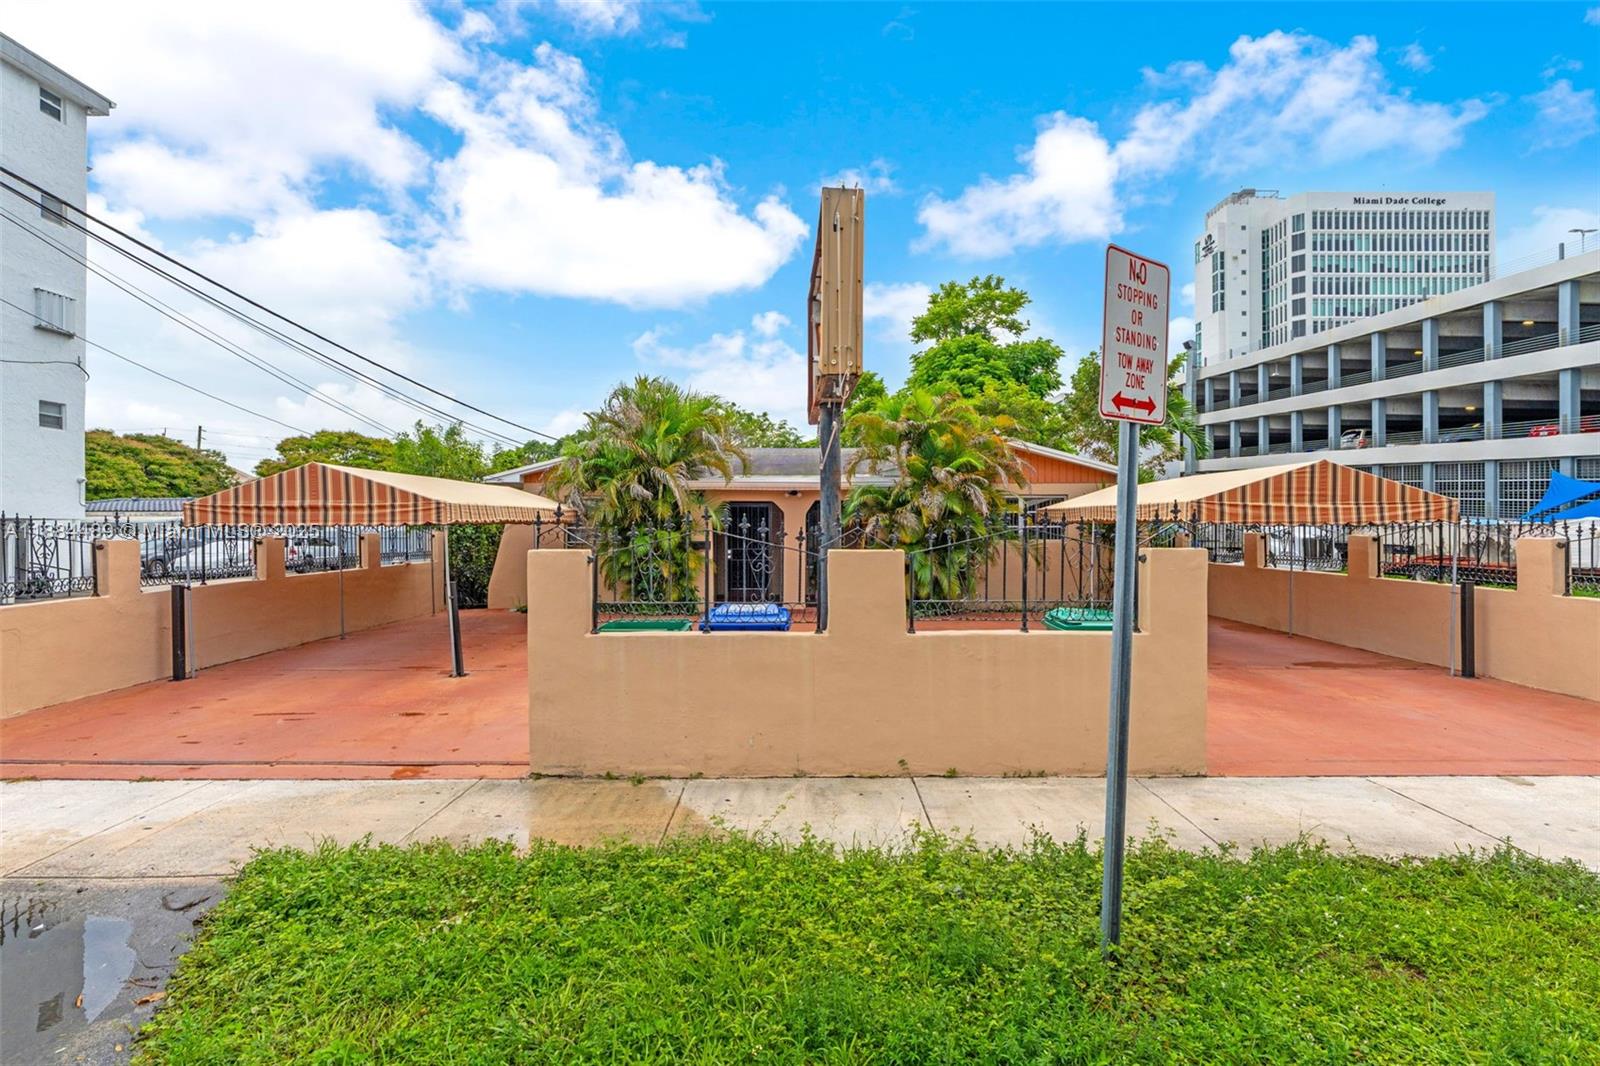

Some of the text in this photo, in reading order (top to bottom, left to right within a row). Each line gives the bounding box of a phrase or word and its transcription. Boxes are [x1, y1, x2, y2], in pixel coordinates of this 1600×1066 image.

[1353, 197, 1446, 206] Miami Dade College
[1129, 258, 1147, 285] NO
[1117, 283, 1158, 310] STOPPING
[1131, 309, 1143, 327] OR
[1115, 327, 1157, 351] STANDING
[1117, 352, 1154, 374] TOW AWAY
[1125, 372, 1145, 391] ZONE
